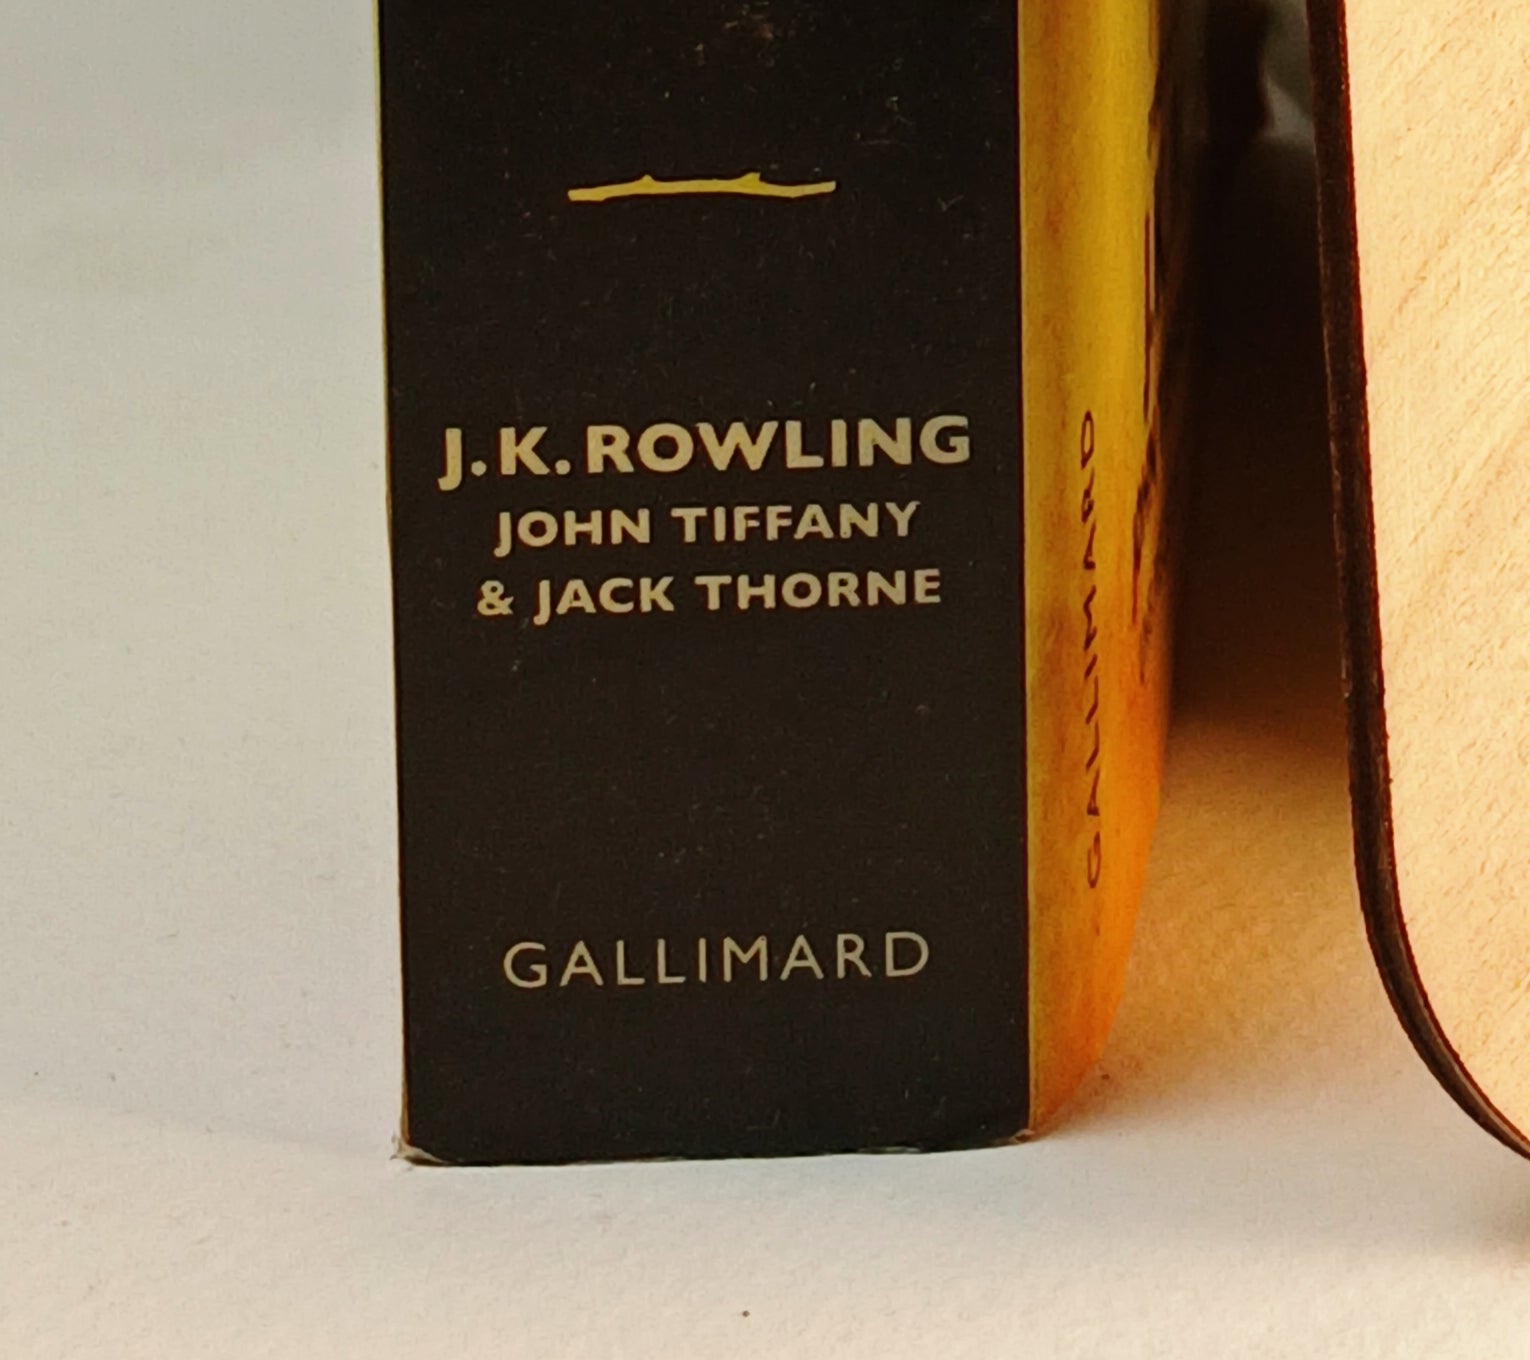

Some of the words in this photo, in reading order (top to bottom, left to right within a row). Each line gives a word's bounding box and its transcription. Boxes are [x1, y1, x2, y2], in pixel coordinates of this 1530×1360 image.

[493, 508, 651, 558] JOHN
[671, 501, 920, 543] TIFFANY
[476, 580, 514, 616] &
[533, 576, 675, 626] JACK
[694, 568, 942, 611] THORNE
[503, 931, 929, 988] GALLIMARD
